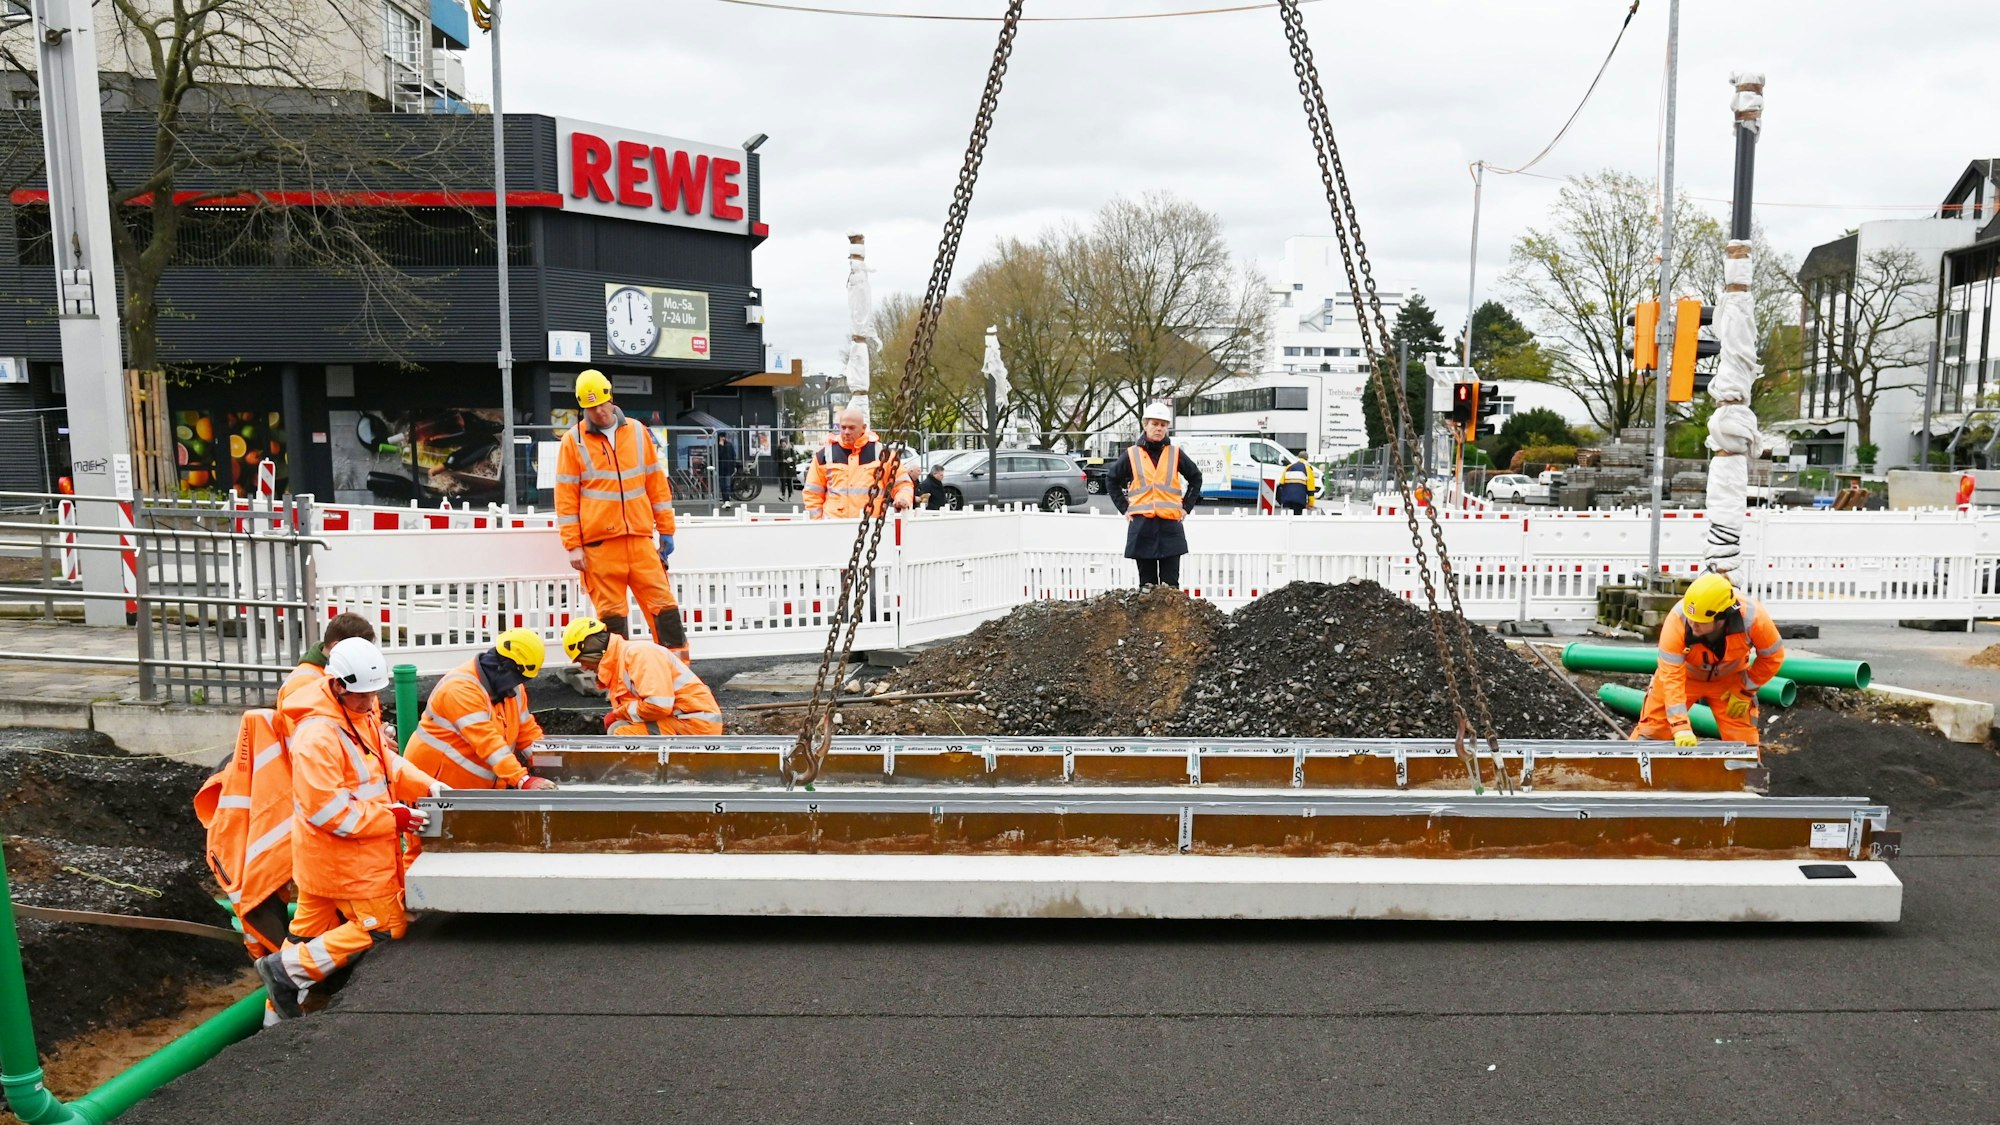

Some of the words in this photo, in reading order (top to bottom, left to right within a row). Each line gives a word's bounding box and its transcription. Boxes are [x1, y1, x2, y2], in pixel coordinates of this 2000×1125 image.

[571, 131, 744, 221] REWE
[664, 297, 694, 310] Mo.-Sa.
[662, 311, 681, 324] 7-24
[682, 313, 696, 324] Uhr
